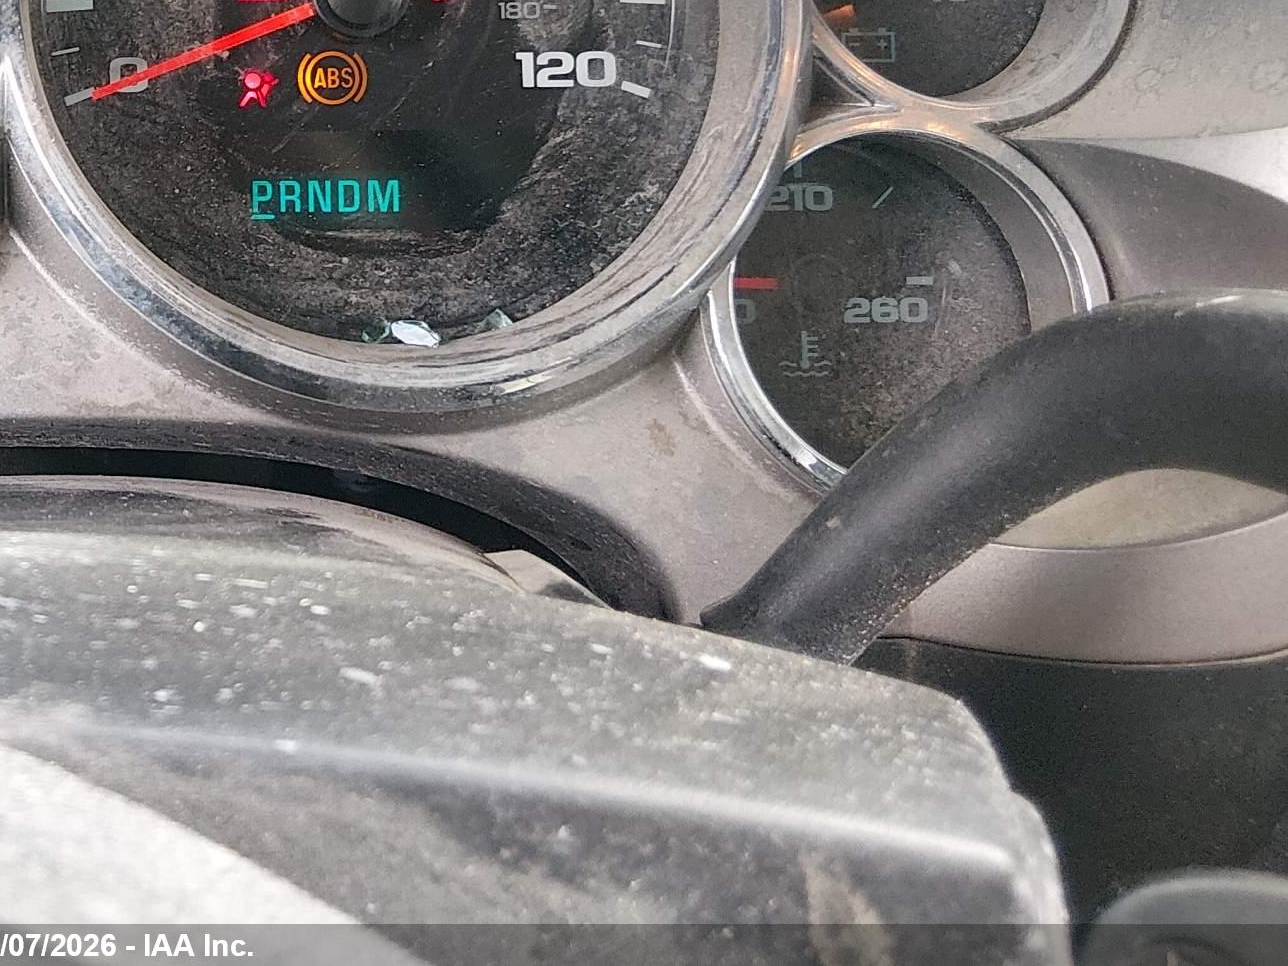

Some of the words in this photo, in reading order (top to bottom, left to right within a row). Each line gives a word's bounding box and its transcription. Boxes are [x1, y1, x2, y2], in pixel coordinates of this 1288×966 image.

[499, 3, 540, 19] 180
[110, 56, 148, 93] 0
[314, 66, 352, 88] ABS
[515, 51, 616, 88] 120
[764, 185, 833, 211] 210
[843, 298, 928, 323] 260
